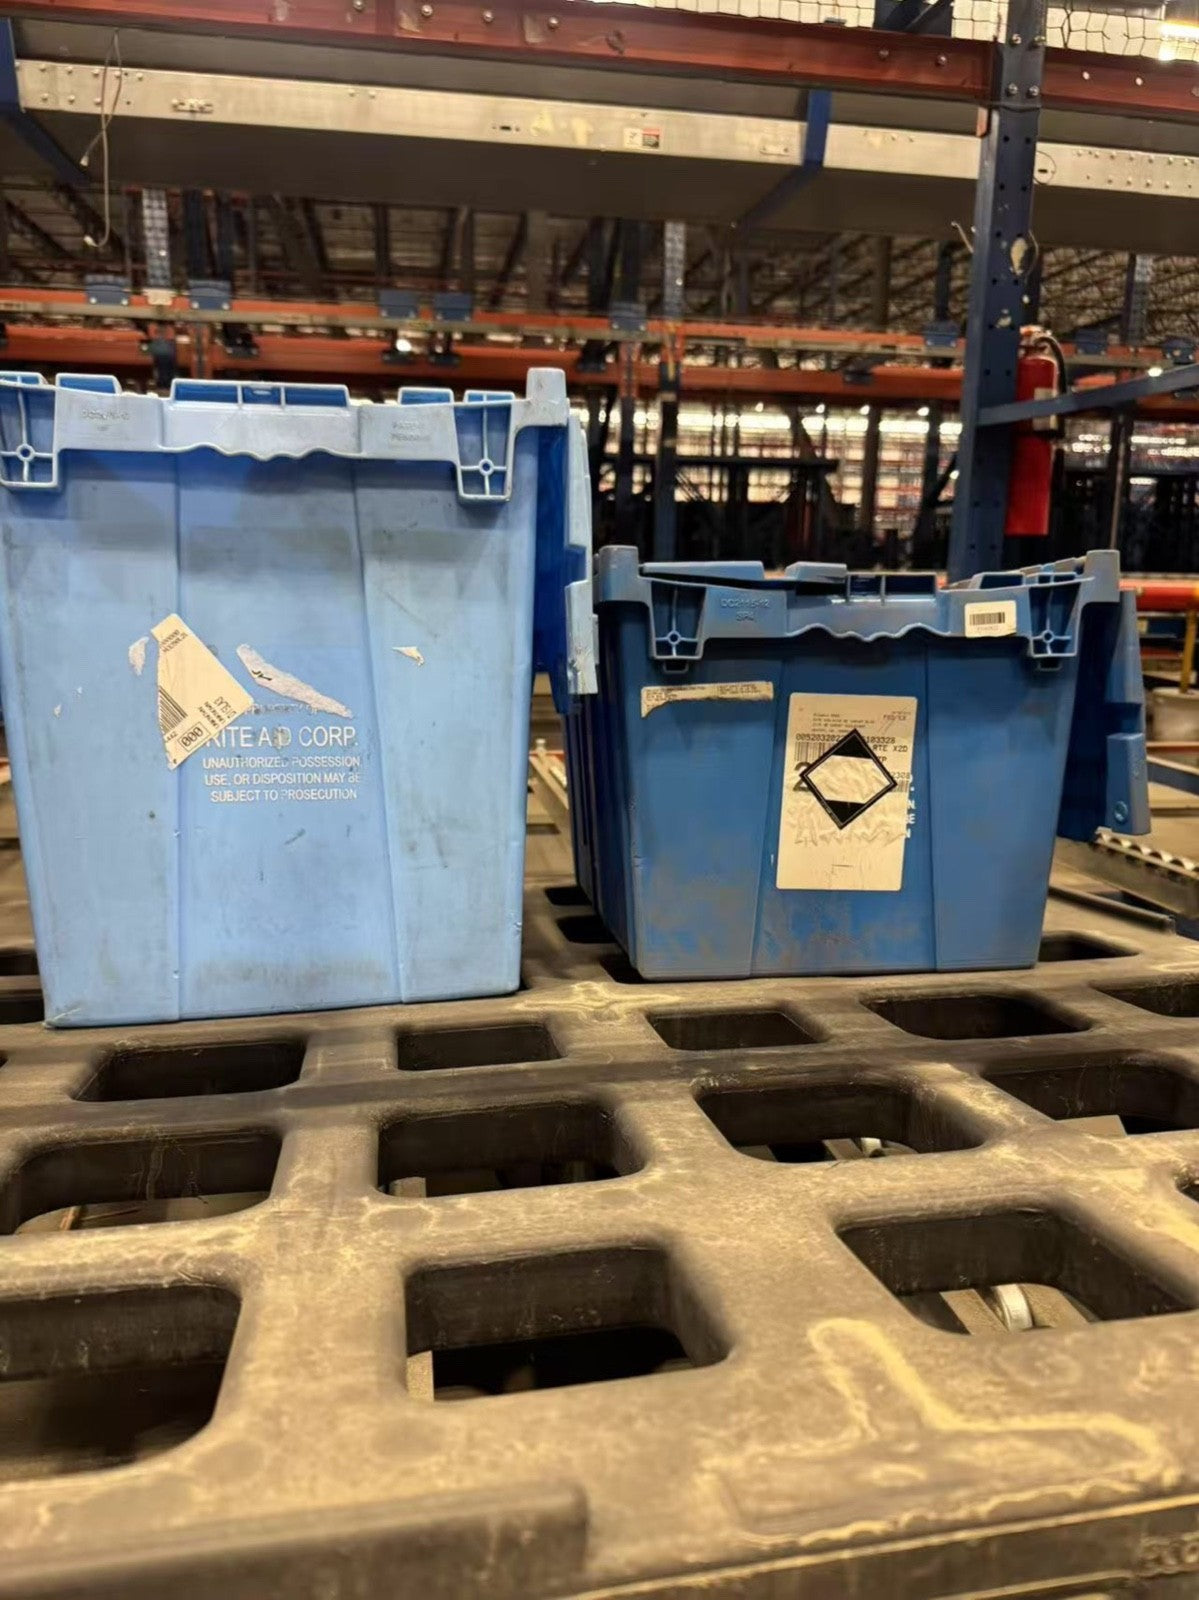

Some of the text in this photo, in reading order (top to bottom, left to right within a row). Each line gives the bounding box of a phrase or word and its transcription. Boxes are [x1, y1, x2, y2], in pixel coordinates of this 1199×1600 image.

[258, 726, 292, 748] AD
[299, 725, 359, 747] CORP.
[233, 773, 250, 785] OR
[253, 772, 321, 785] DISPOSITION
[324, 772, 346, 784] MAY
[210, 789, 260, 802] SUBJECT
[263, 789, 279, 801] TO
